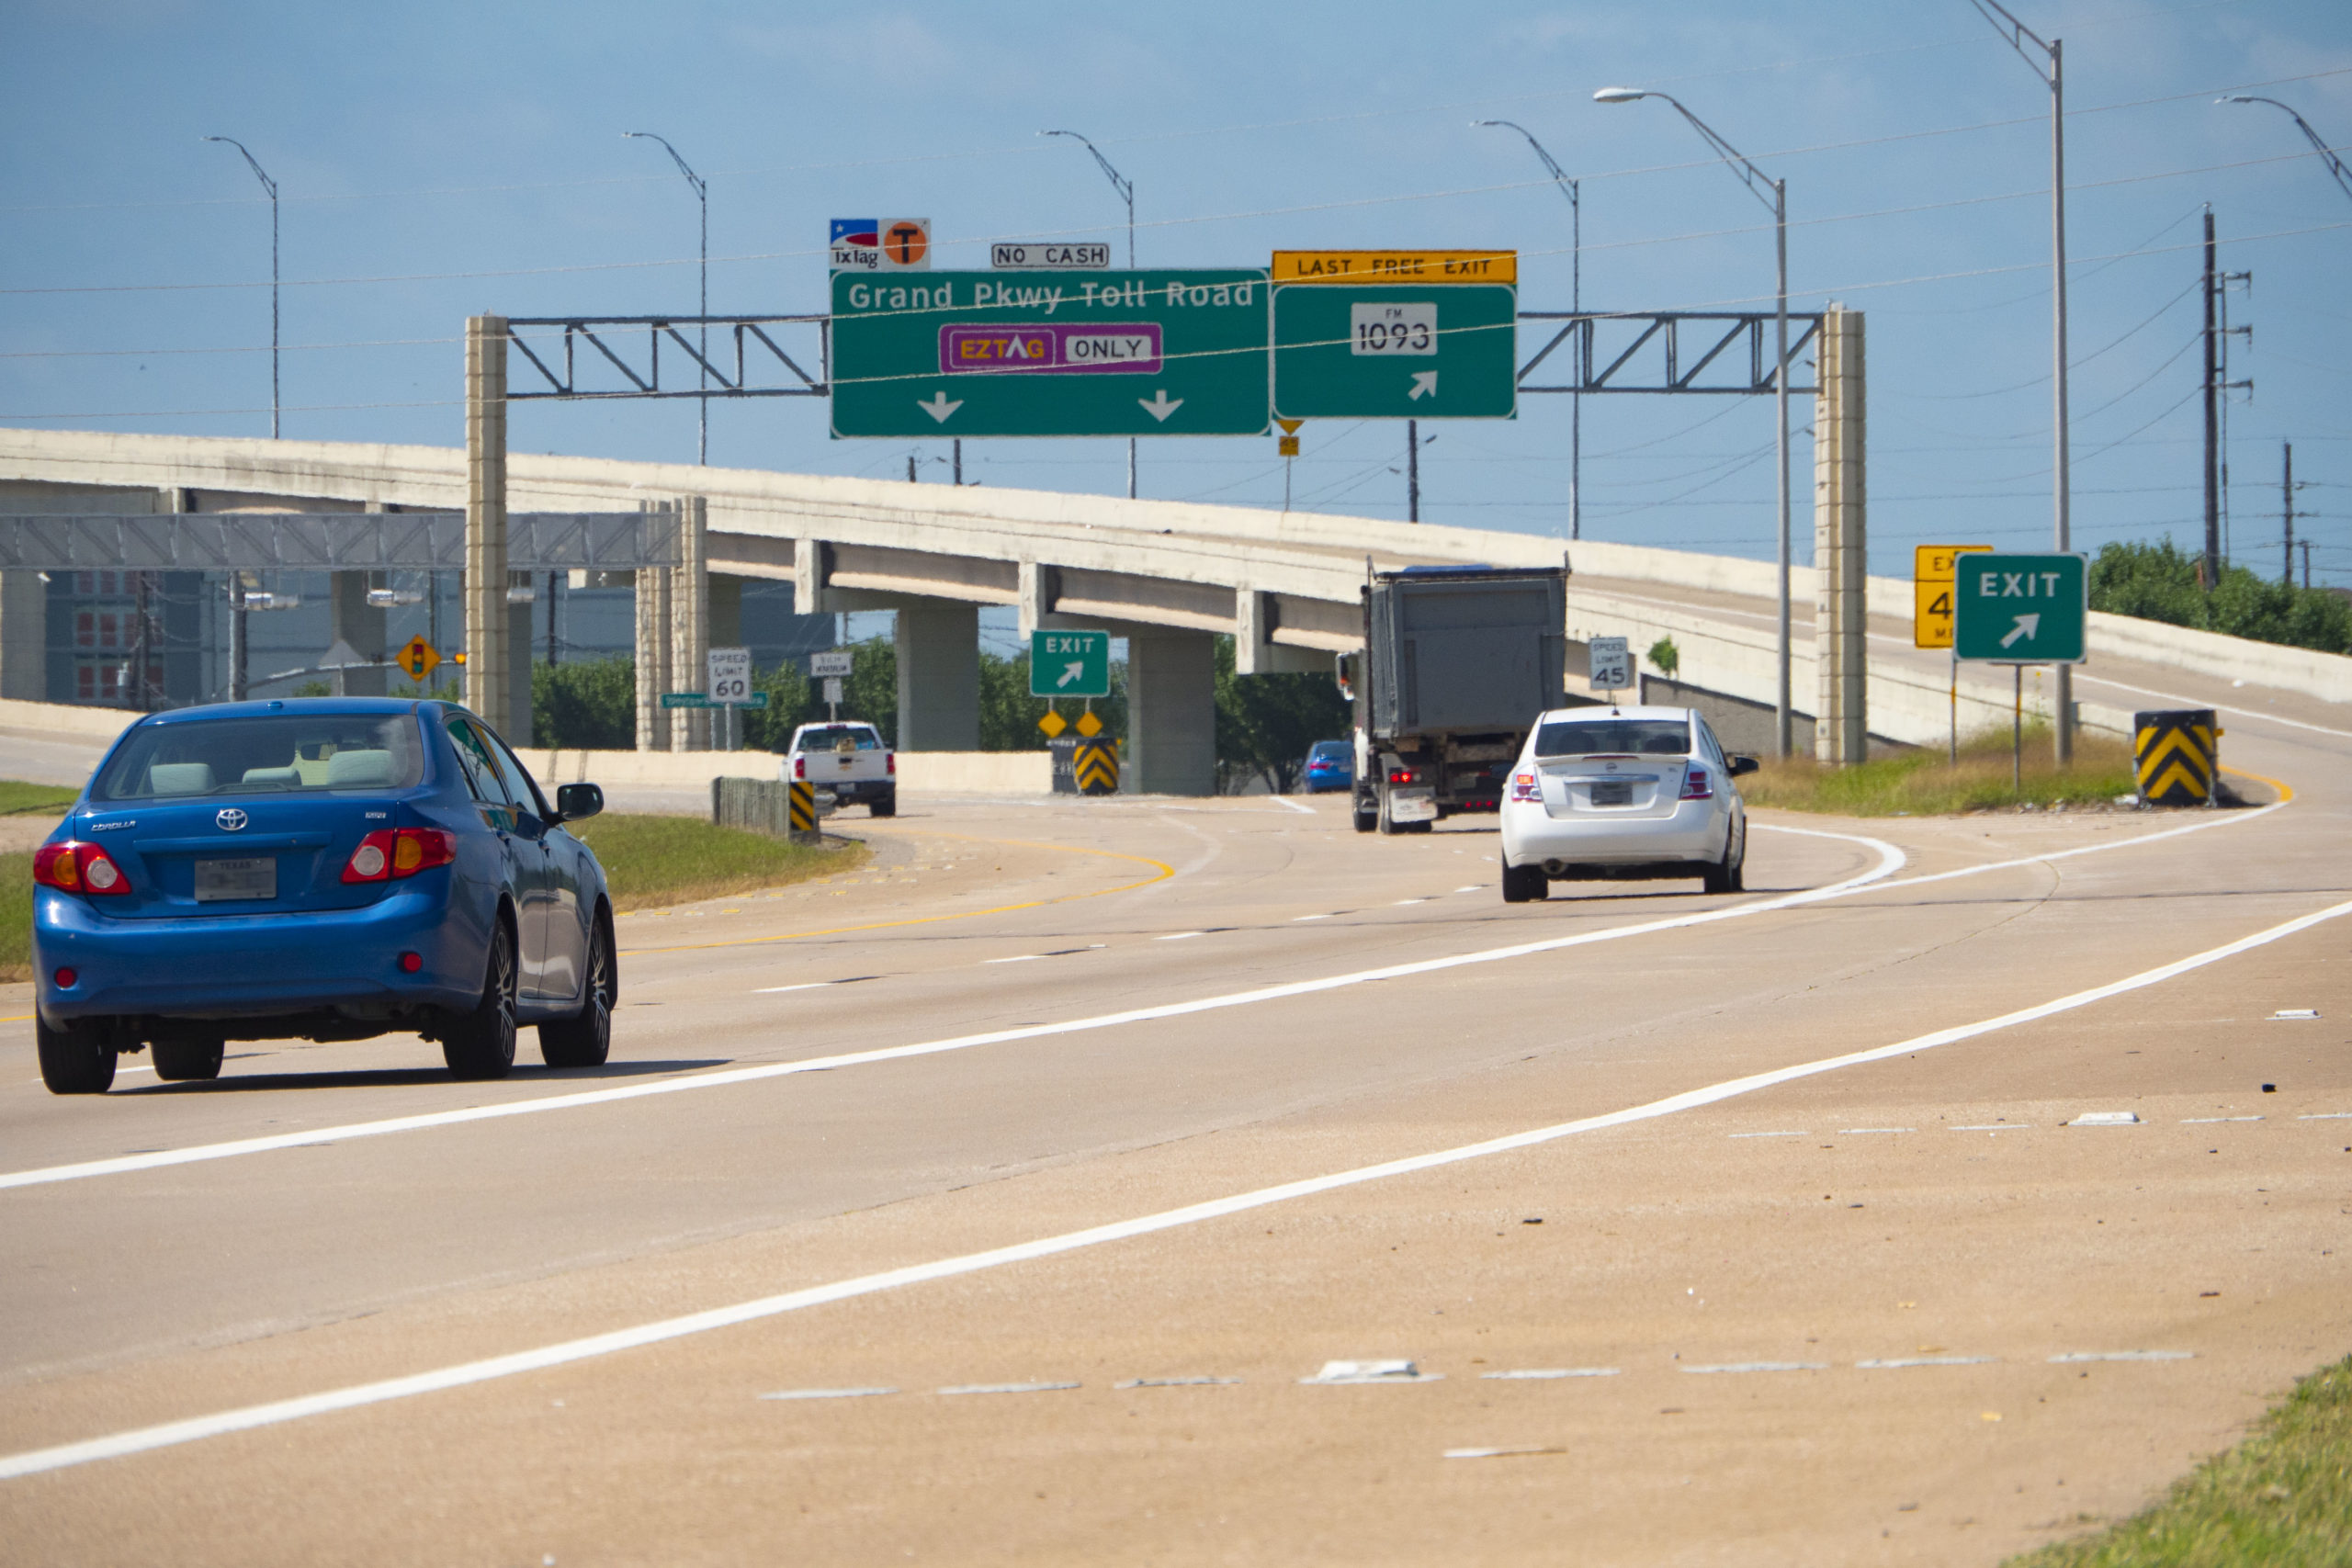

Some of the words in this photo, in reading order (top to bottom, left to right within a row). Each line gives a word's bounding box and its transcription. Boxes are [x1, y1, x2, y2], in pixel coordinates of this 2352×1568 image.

[997, 248, 1025, 263] NO
[1046, 247, 1104, 263] CASH
[1297, 259, 1351, 275] LAST
[1372, 259, 1425, 274] FREE
[1444, 259, 1490, 274] EXIT
[849, 282, 952, 309] Grand
[974, 282, 1061, 314] Pkwy
[1080, 281, 1147, 307] Toll
[1166, 280, 1253, 307] Road
[1385, 309, 1402, 319] FM
[1359, 323, 1430, 350] 1093
[1075, 340, 1141, 357] ONLY
[1980, 572, 2061, 597] EXIT
[1046, 637, 1095, 653] EXIT
[711, 654, 747, 663] SPEED
[1594, 667, 1625, 684] 45
[717, 680, 744, 696] 60
[91, 820, 136, 831] COROLLA
